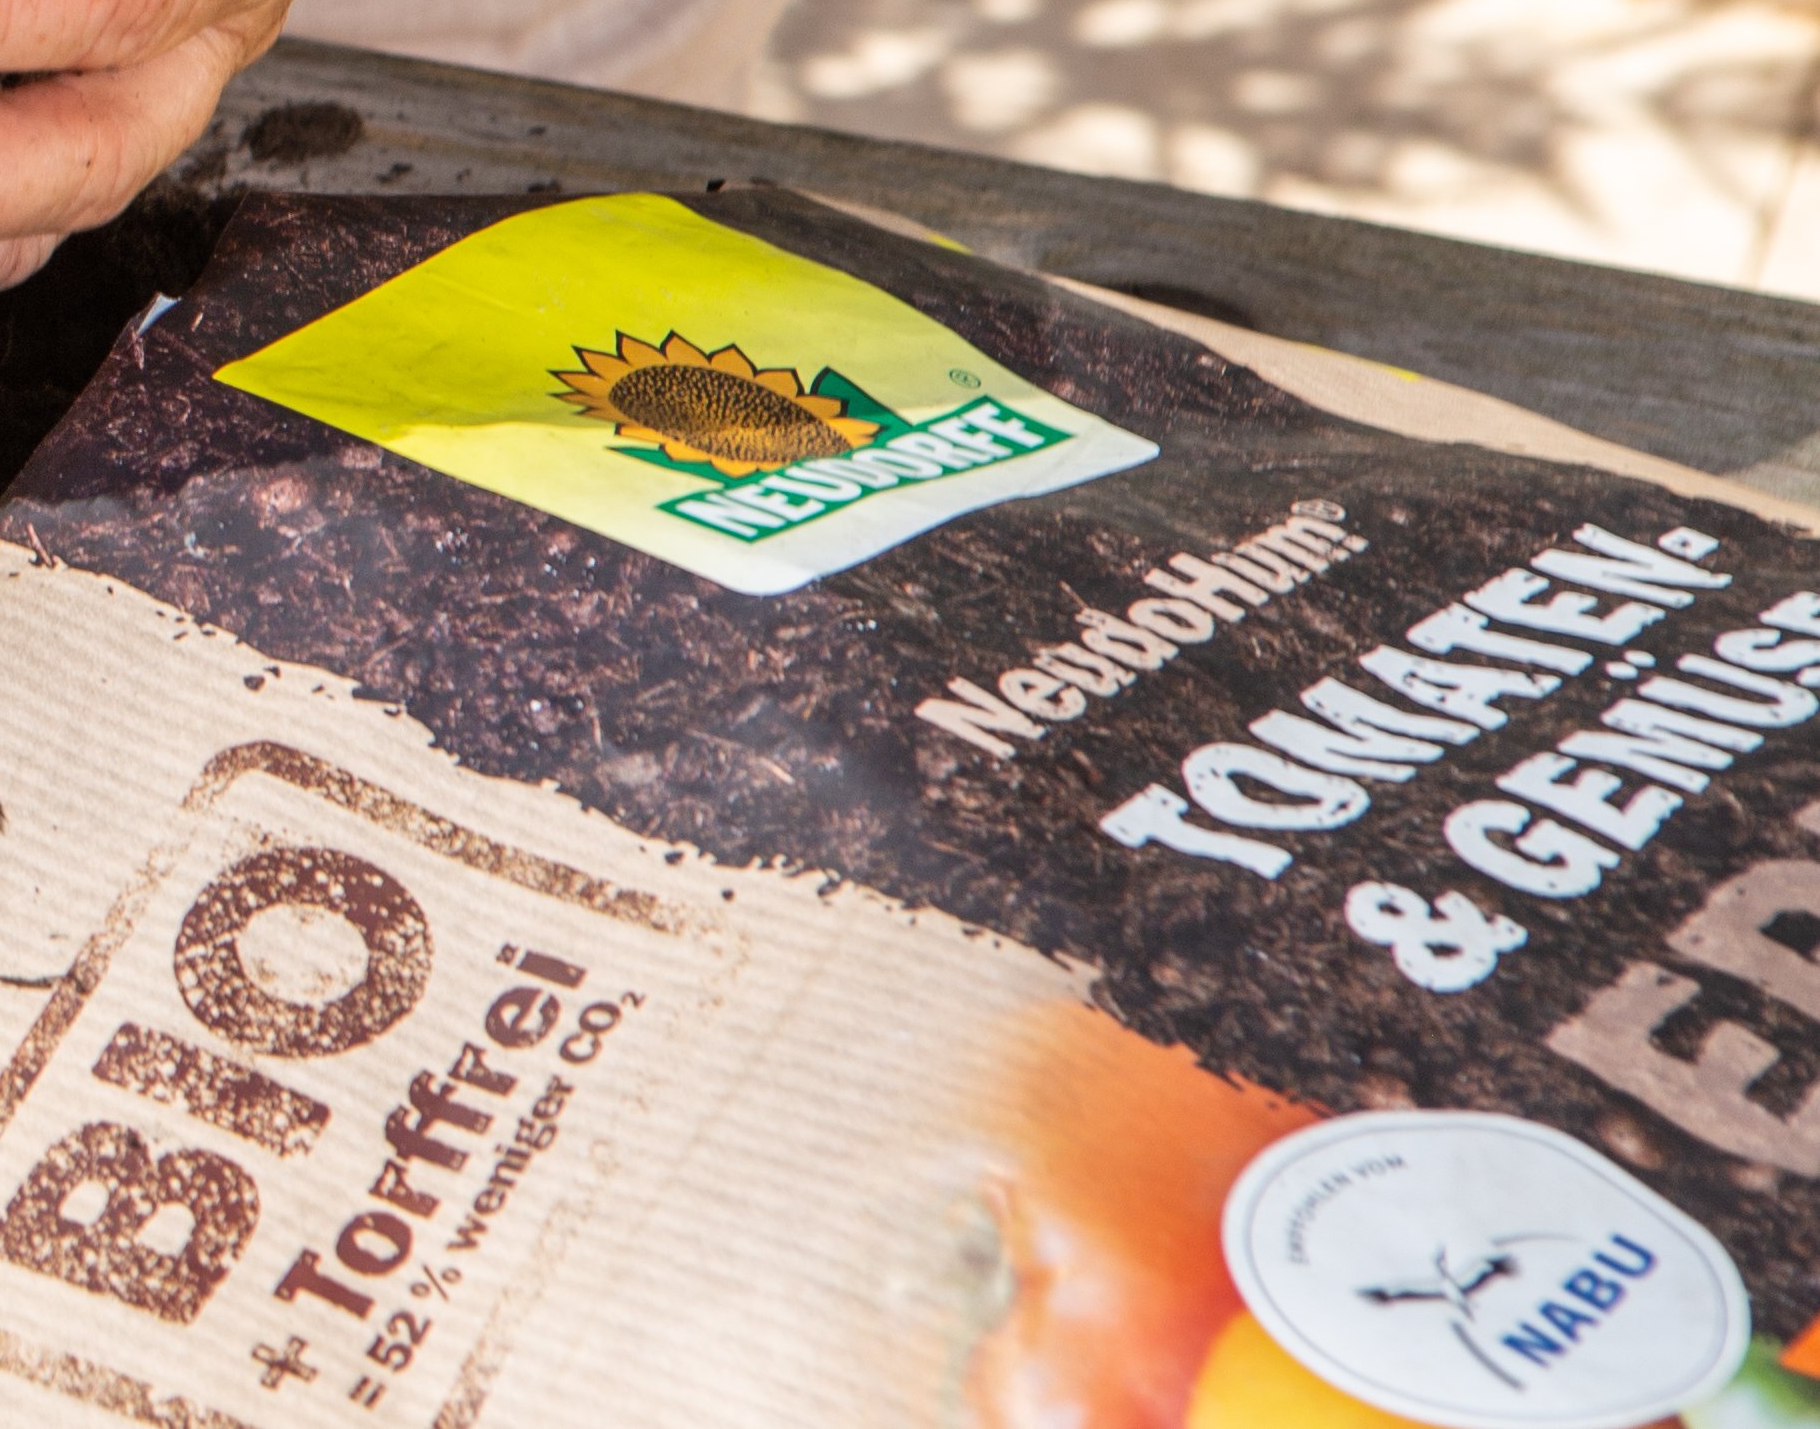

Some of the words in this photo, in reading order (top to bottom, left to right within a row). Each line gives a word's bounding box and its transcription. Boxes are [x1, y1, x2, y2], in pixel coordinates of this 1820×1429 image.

[675, 401, 1046, 540] NEUDORFF
[1343, 880, 1528, 994] &
[272, 943, 588, 1322] Torffrei
[446, 1074, 576, 1254] weniger
[1499, 1232, 1659, 1370] NABU
